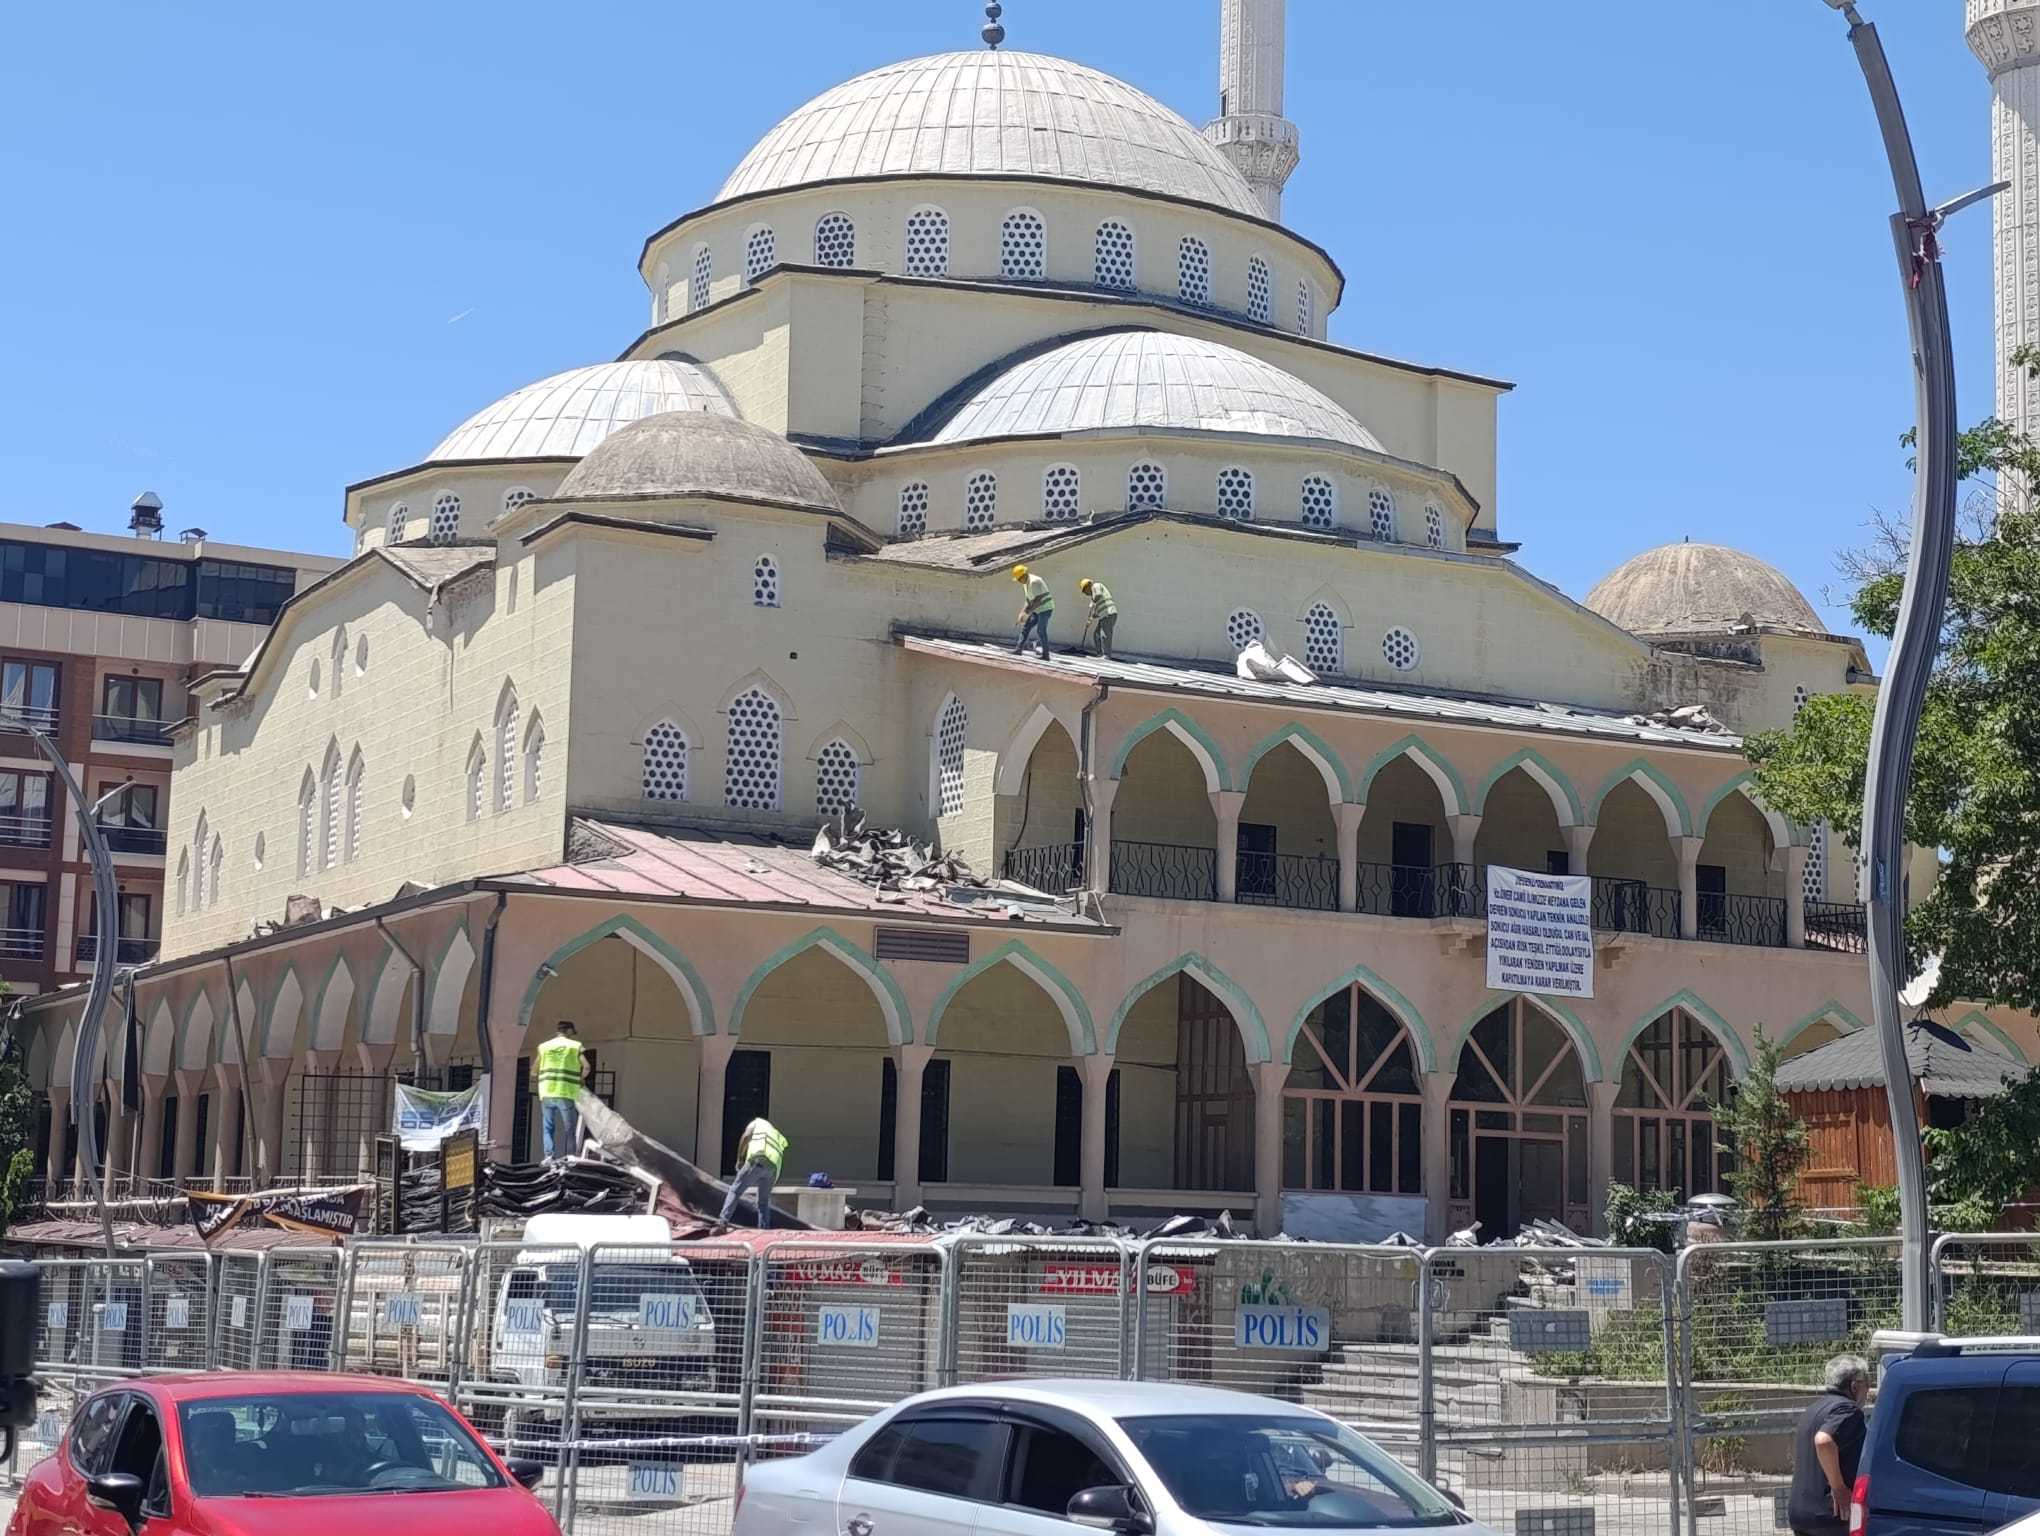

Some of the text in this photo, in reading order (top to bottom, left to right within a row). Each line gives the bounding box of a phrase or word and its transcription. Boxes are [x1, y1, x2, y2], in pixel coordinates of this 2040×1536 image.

[508, 1301, 542, 1331] POLİS
[645, 1296, 690, 1329] POLİS
[1011, 1311, 1064, 1345] POLİS
[1243, 1308, 1319, 1347] POLİS
[632, 1463, 676, 1495] POLİS
